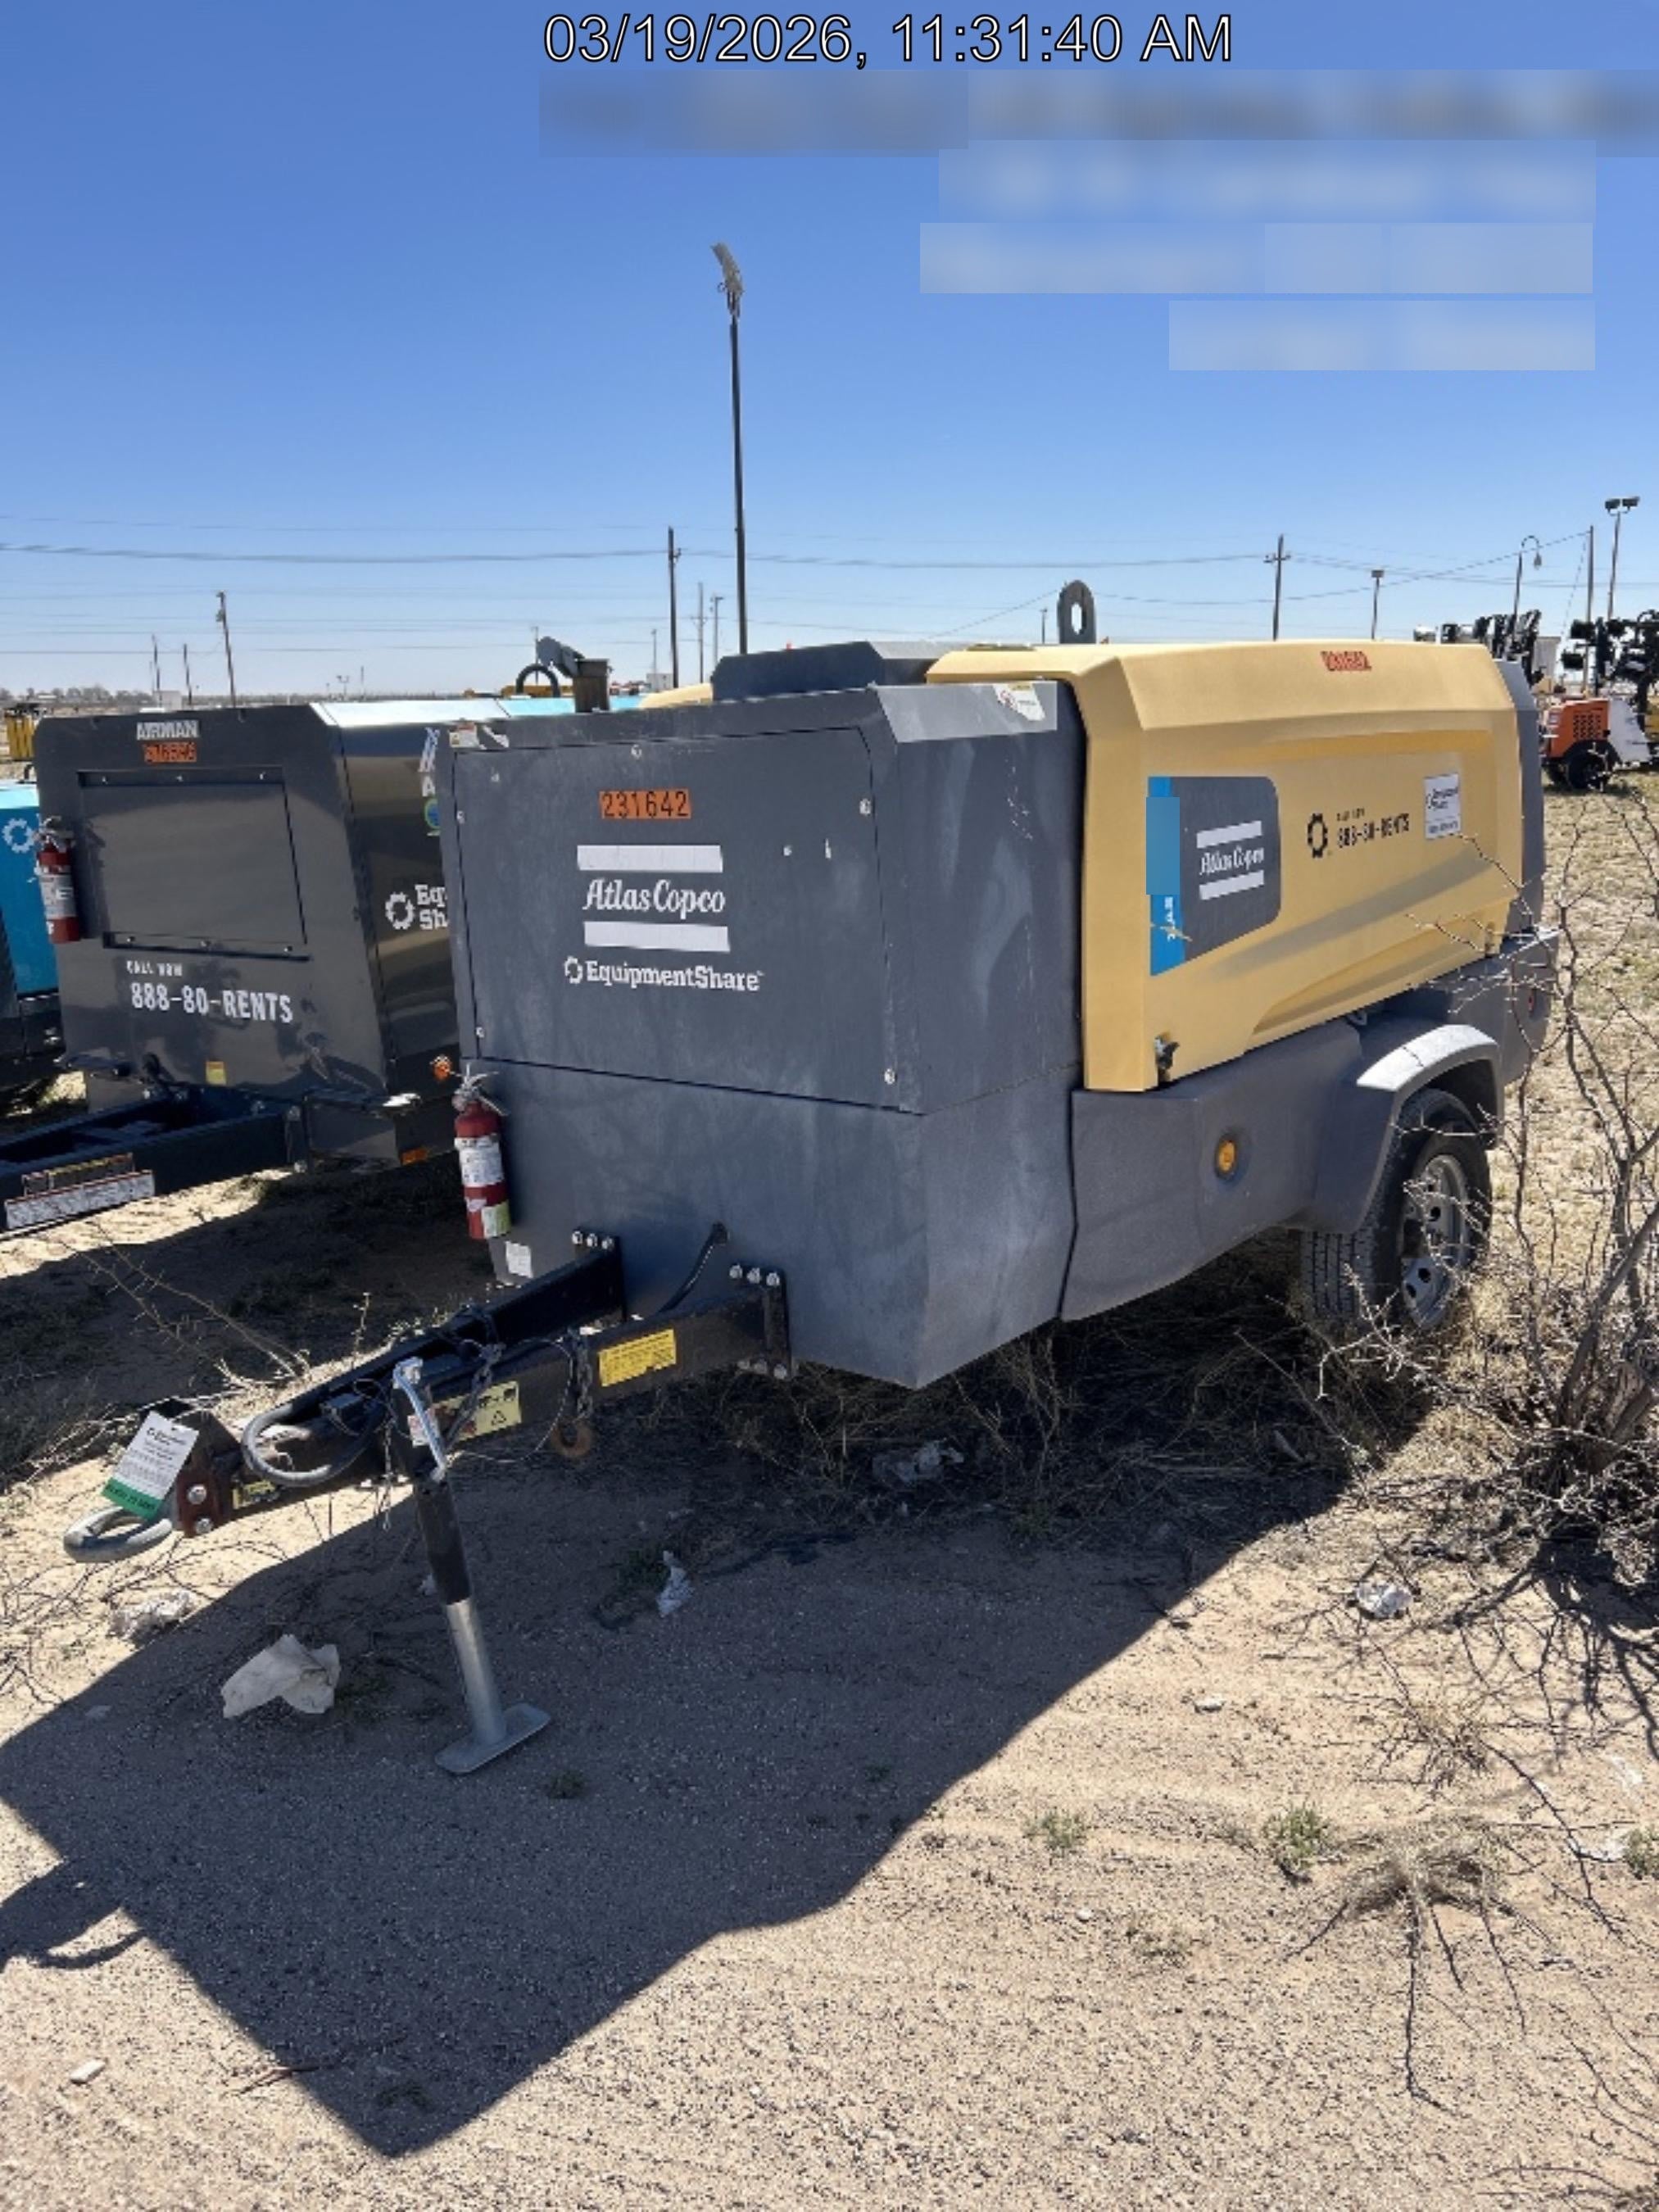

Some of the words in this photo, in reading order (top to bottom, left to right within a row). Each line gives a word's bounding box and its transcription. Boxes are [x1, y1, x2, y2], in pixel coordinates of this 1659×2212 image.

[601, 790, 689, 818] 231642
[582, 877, 650, 910] Atlas
[653, 878, 726, 920] Copco
[585, 960, 760, 991] EquipmentShare
[131, 982, 293, 1024] 888-80-RENTS
